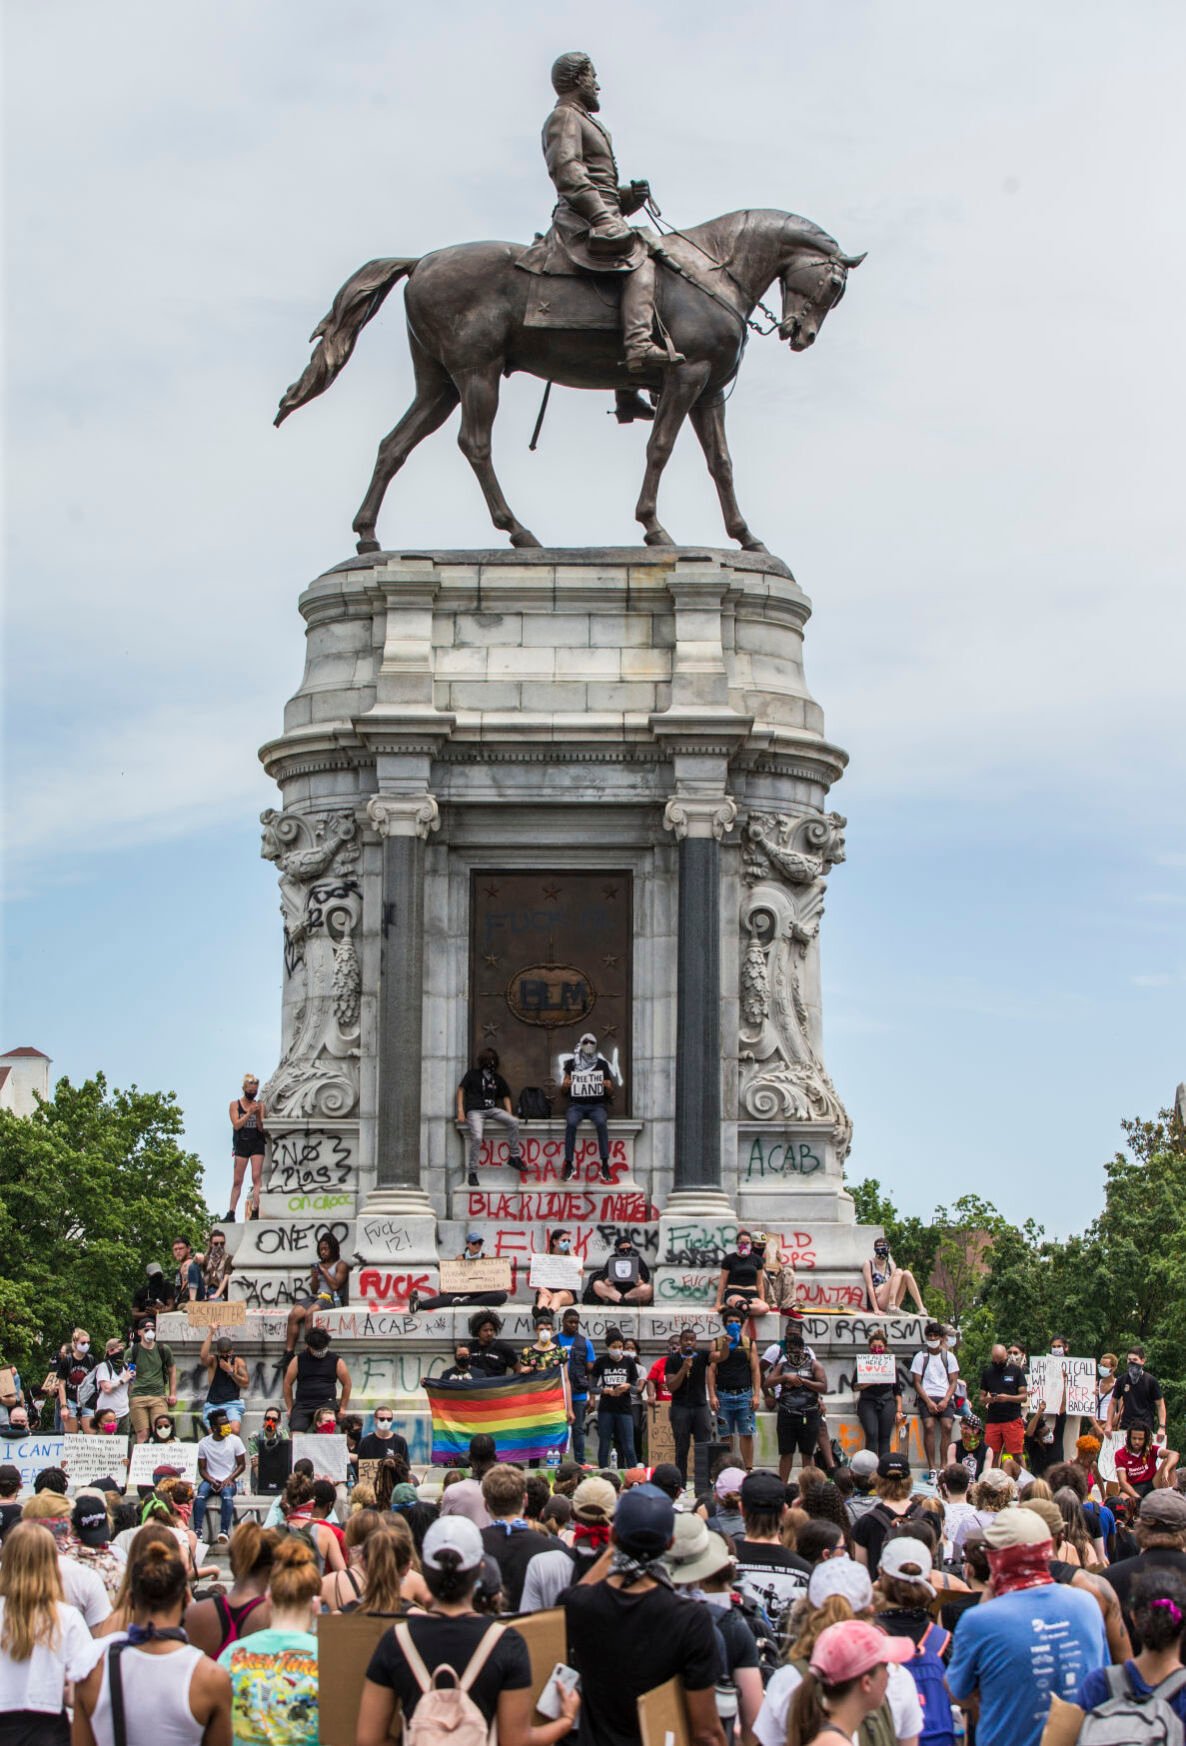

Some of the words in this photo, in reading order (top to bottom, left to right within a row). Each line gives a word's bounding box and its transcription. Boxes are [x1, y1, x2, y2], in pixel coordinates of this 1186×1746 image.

[520, 978, 588, 1010] BLM
[572, 1074, 587, 1082] FREE
[573, 1083, 604, 1096] LAND
[746, 1137, 820, 1180] ACAB
[468, 1192, 533, 1221] BLACK
[364, 1219, 402, 1245] FUCK
[596, 1224, 659, 1251] FUCK
[358, 1269, 437, 1300] FUCK
[364, 1313, 418, 1336] ACAB
[652, 1318, 727, 1339] BLOOD
[801, 1317, 830, 1339] ND
[1074, 1361, 1096, 1376] CALL
[1066, 1375, 1080, 1387] HE
[1068, 1401, 1095, 1414] BADGE
[3, 1442, 14, 1460] I
[18, 1442, 64, 1459] CANT
